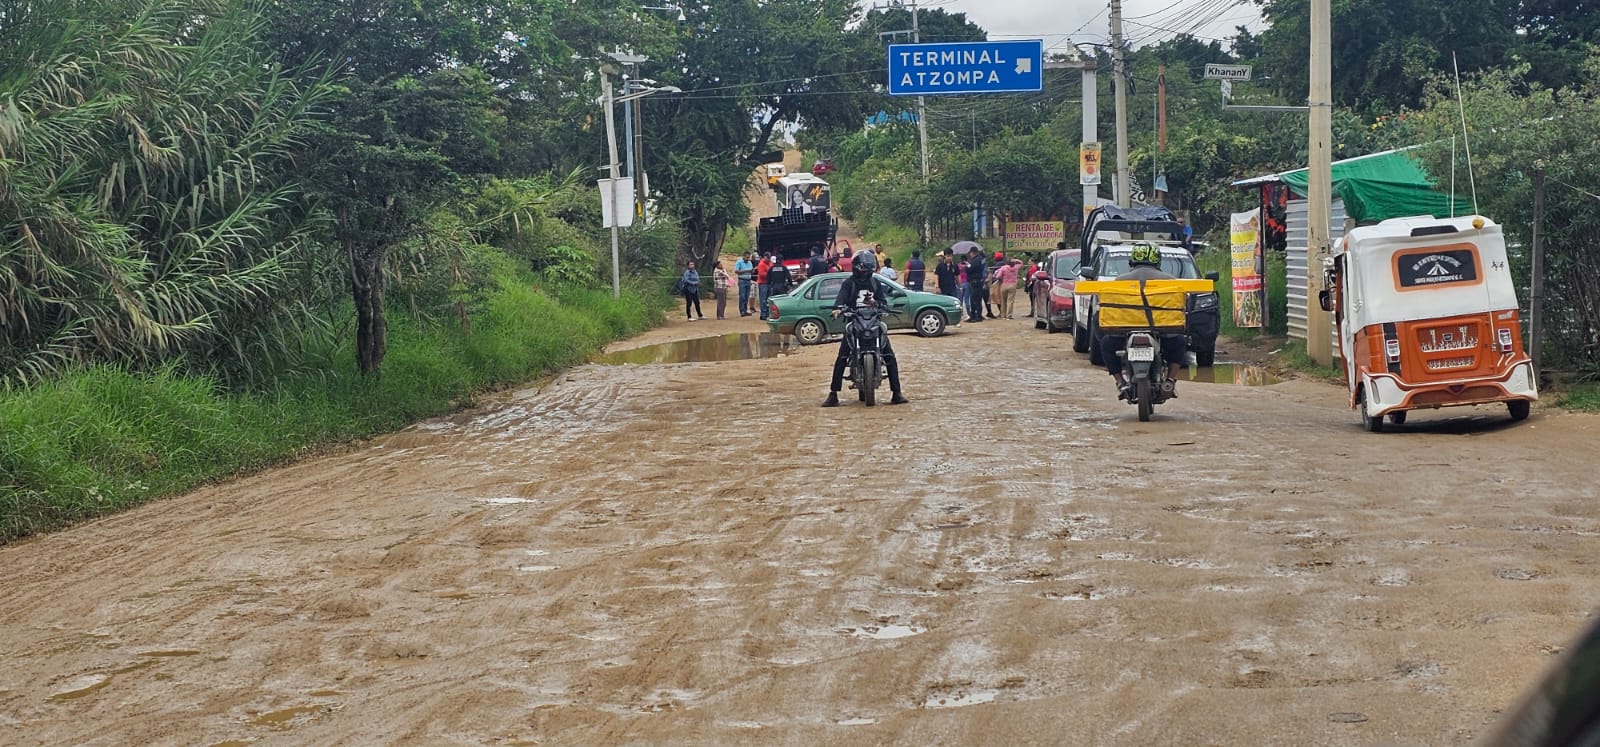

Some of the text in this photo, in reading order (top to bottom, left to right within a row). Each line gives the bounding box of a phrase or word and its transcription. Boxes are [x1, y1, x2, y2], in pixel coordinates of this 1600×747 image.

[900, 50, 1006, 67] TERMINAL
[901, 70, 1000, 86] ATZOMPA
[1208, 67, 1248, 77] KhananY
[1016, 224, 1040, 232] RENTA
